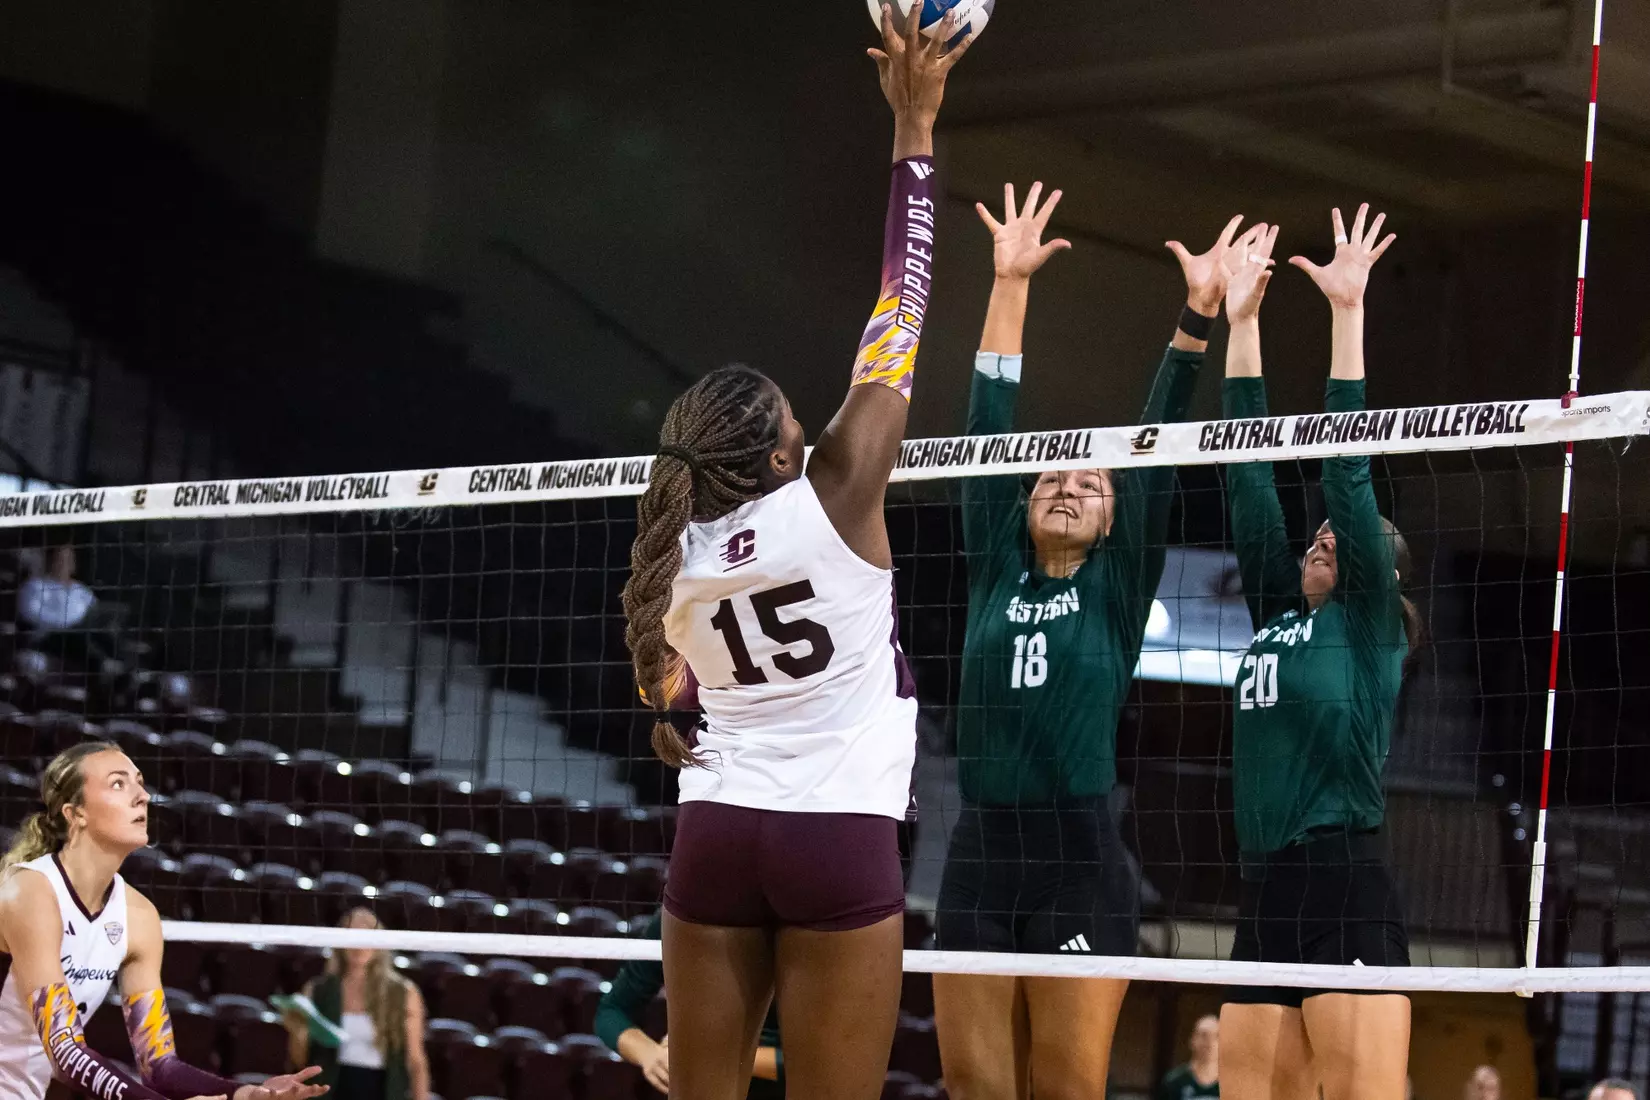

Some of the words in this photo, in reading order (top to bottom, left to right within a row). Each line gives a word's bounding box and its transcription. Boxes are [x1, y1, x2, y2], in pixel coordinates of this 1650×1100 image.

[896, 194, 934, 338] CHIPPEWAS
[1198, 417, 1287, 452] CENTRAL
[1291, 411, 1397, 446] MICHIGAN
[1400, 403, 1530, 440] VOLLEYBALL
[1583, 405, 1611, 416] imports
[980, 430, 1092, 465] VOLLEYBALL
[174, 484, 230, 507] CENTRAL
[235, 479, 301, 504] MICHIGAN
[305, 475, 390, 501] VOLLEYBALL
[469, 467, 532, 493] CENTRAL
[537, 462, 617, 490] MICHIGAN
[32, 490, 105, 516] VOLLEYBALL
[710, 579, 835, 685] 15
[1011, 631, 1048, 688] 18
[1240, 653, 1278, 710] 20
[49, 1027, 128, 1100] CHIPPEWAS
